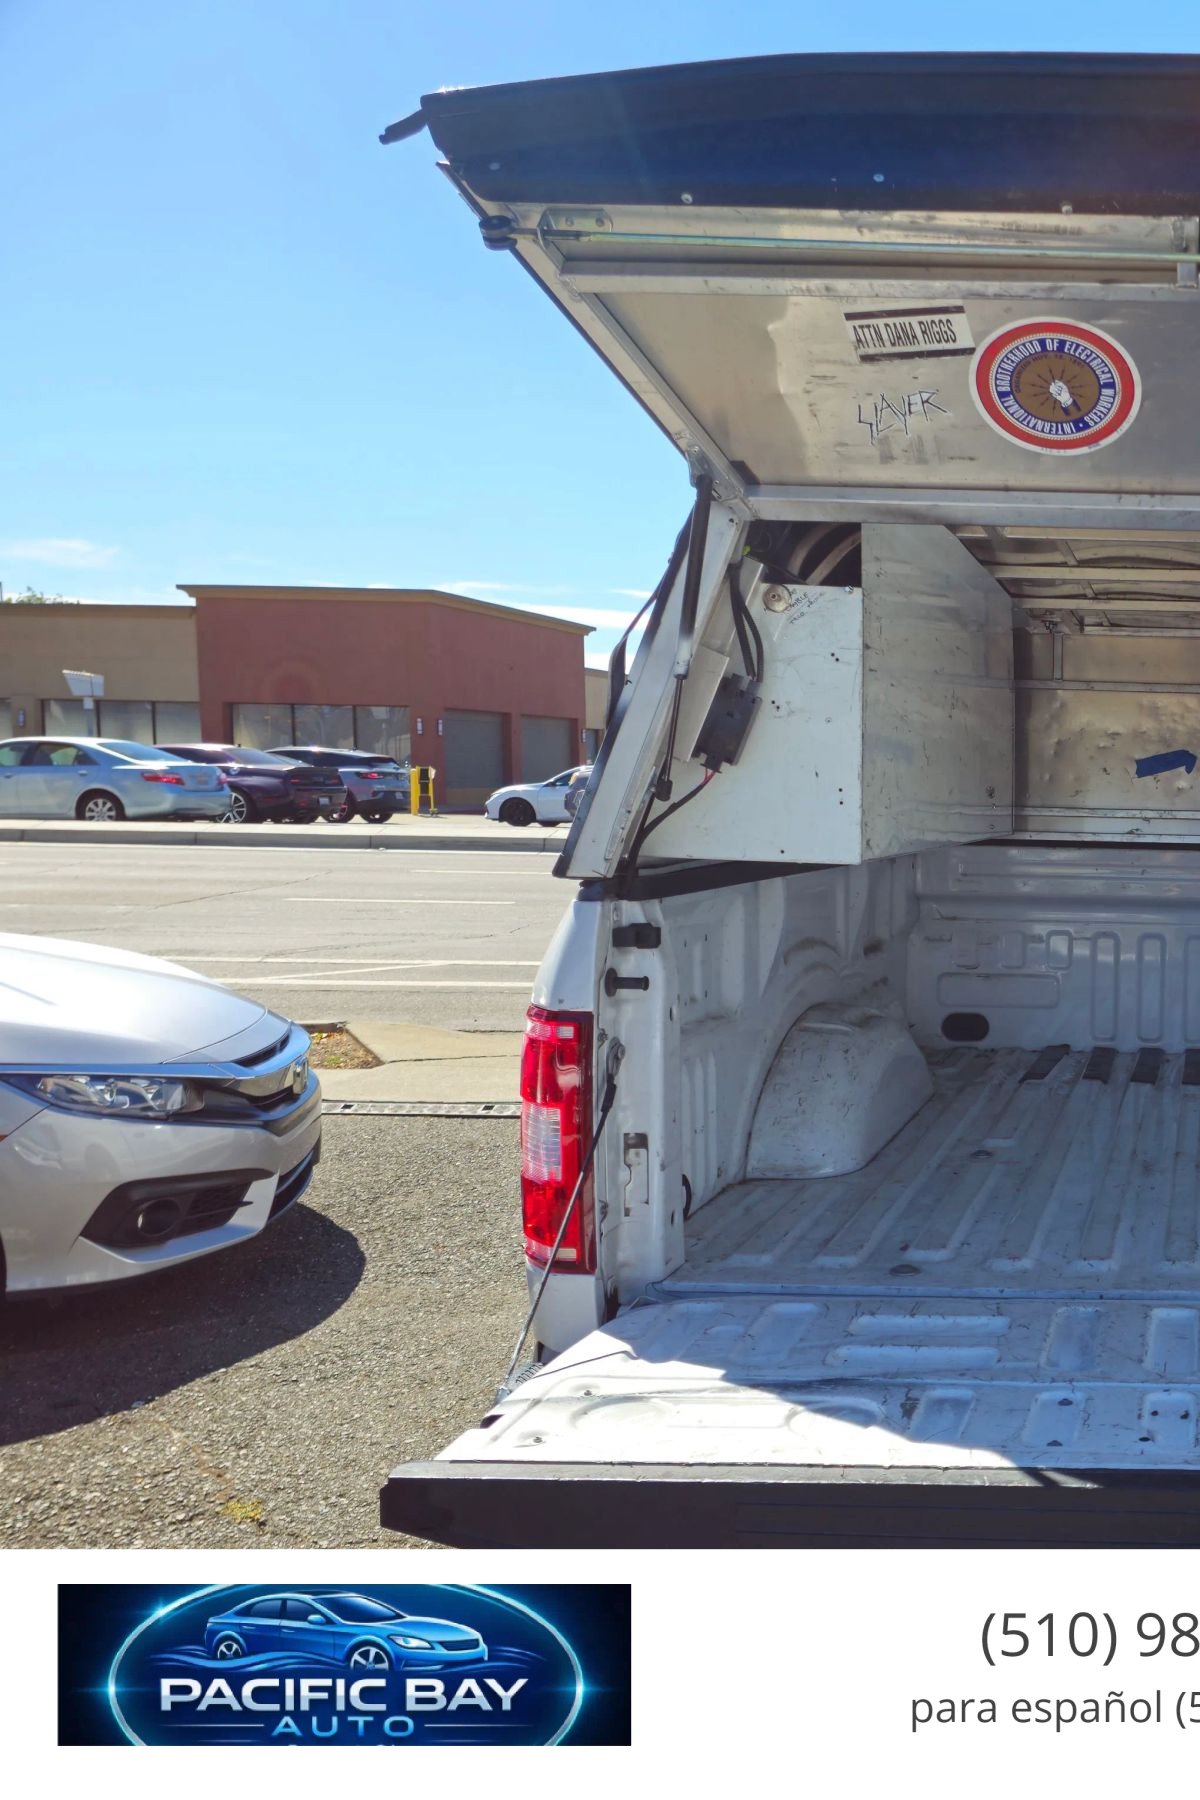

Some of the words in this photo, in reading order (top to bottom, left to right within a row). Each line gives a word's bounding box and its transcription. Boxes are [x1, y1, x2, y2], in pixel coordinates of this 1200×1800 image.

[853, 324, 886, 350] ATTN
[886, 321, 920, 347] DANA
[922, 318, 957, 345] RIGGS
[1045, 339, 1060, 351] OF
[996, 339, 1042, 392] BROTHERHOOD
[1064, 341, 1114, 385] ELECTRICAL
[857, 388, 951, 446] SLAYER
[1001, 394, 1077, 435] INTERNATIONAL
[1084, 388, 1115, 427] WORKERS
